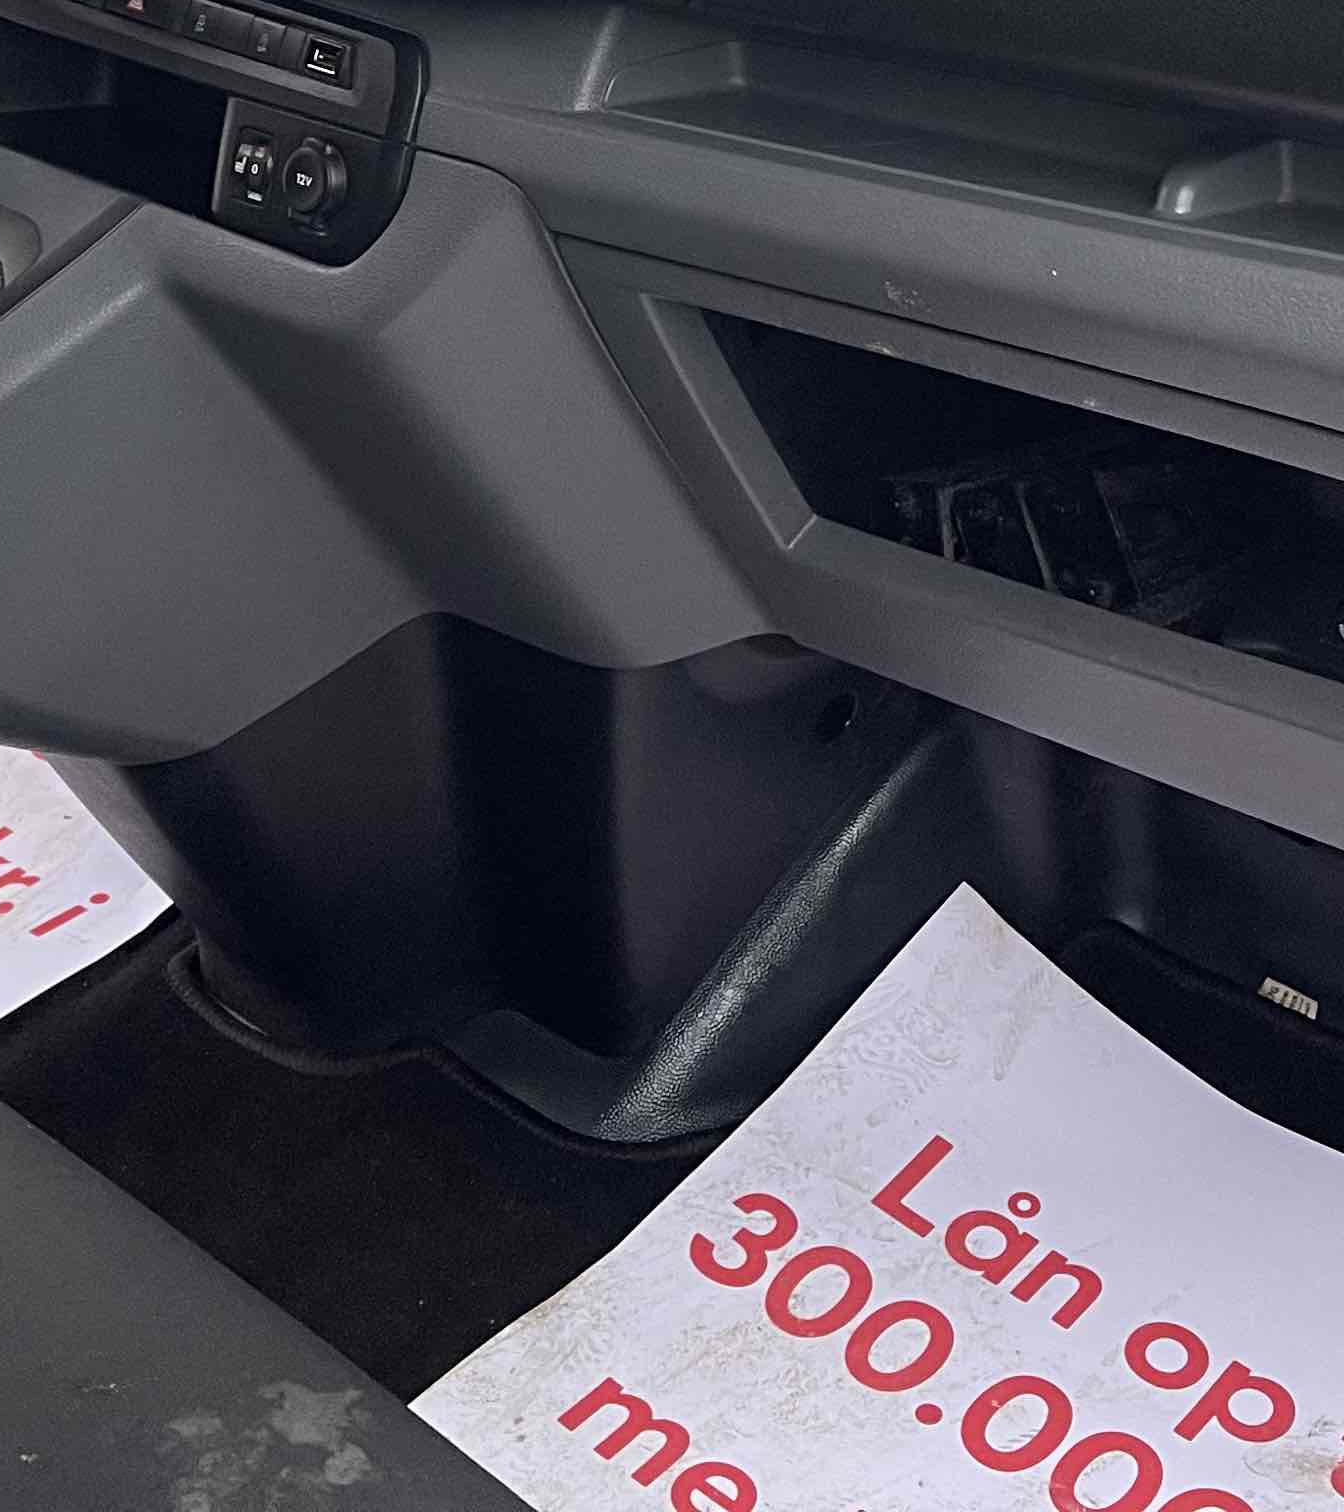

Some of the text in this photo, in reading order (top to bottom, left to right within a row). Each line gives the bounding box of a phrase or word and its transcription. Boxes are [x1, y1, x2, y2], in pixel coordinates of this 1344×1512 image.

[295, 172, 313, 187] 12V
[31, 890, 111, 938] i
[688, 1192, 1256, 1512] 300.00
[871, 1134, 1104, 1330] Lån
[1123, 1321, 1297, 1444] op
